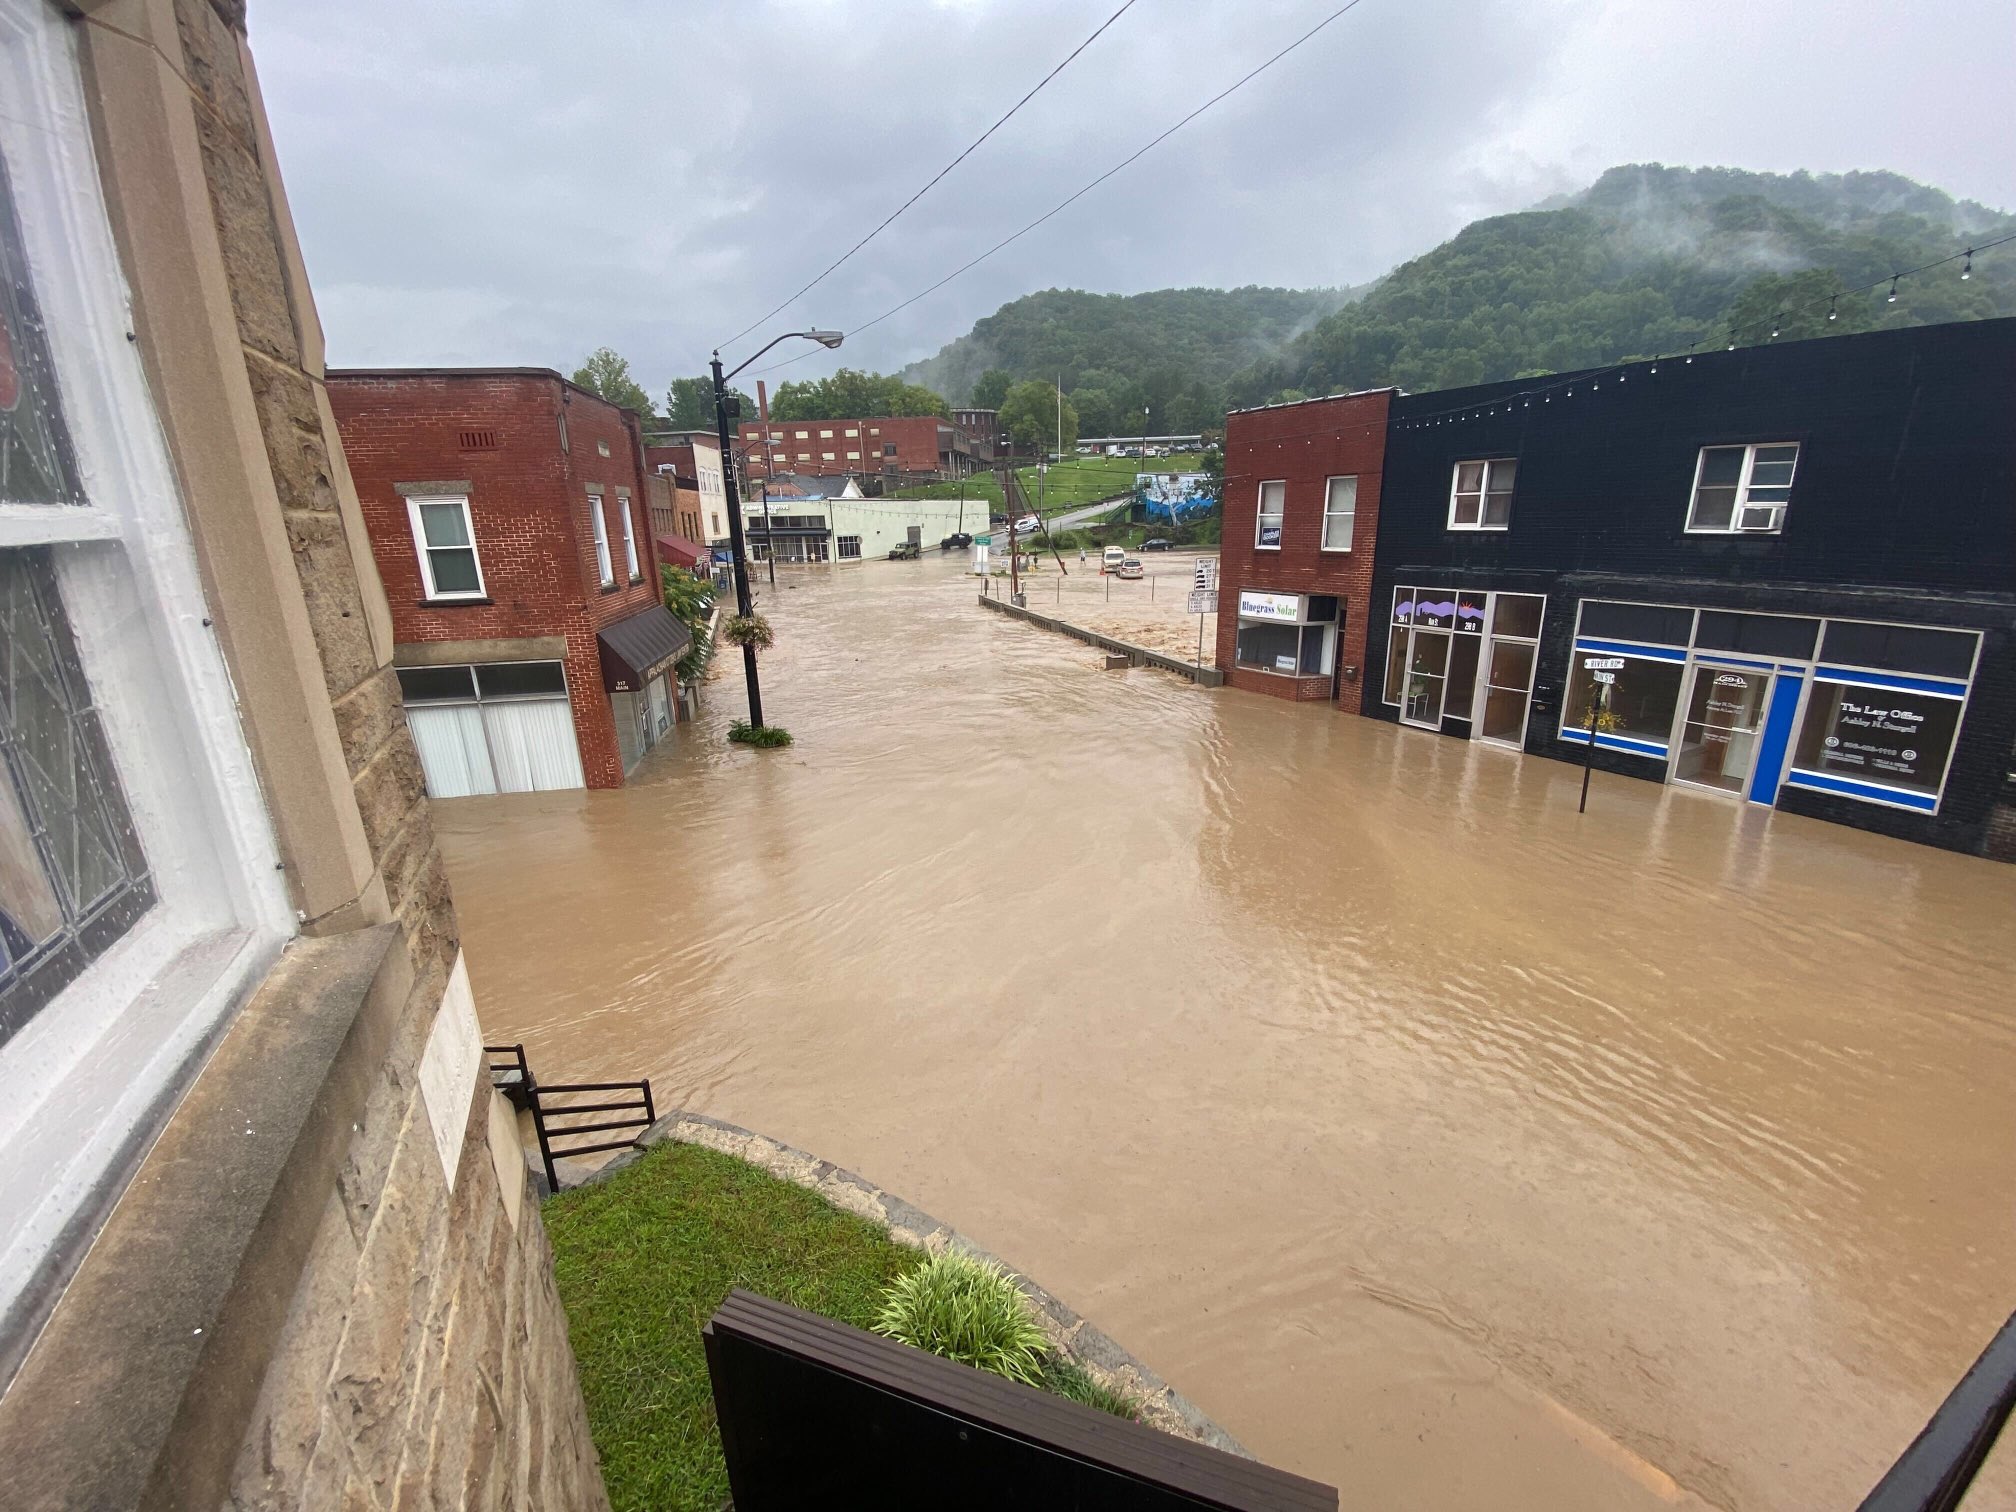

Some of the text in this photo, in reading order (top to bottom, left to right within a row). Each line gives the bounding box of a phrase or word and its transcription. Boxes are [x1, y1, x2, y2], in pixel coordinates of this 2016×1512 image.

[1242, 601, 1297, 616] Bluegrass Solar
[1604, 674, 1612, 682] ST
[1841, 702, 1924, 722] The Law Office
[1841, 715, 1871, 727] Ashley
